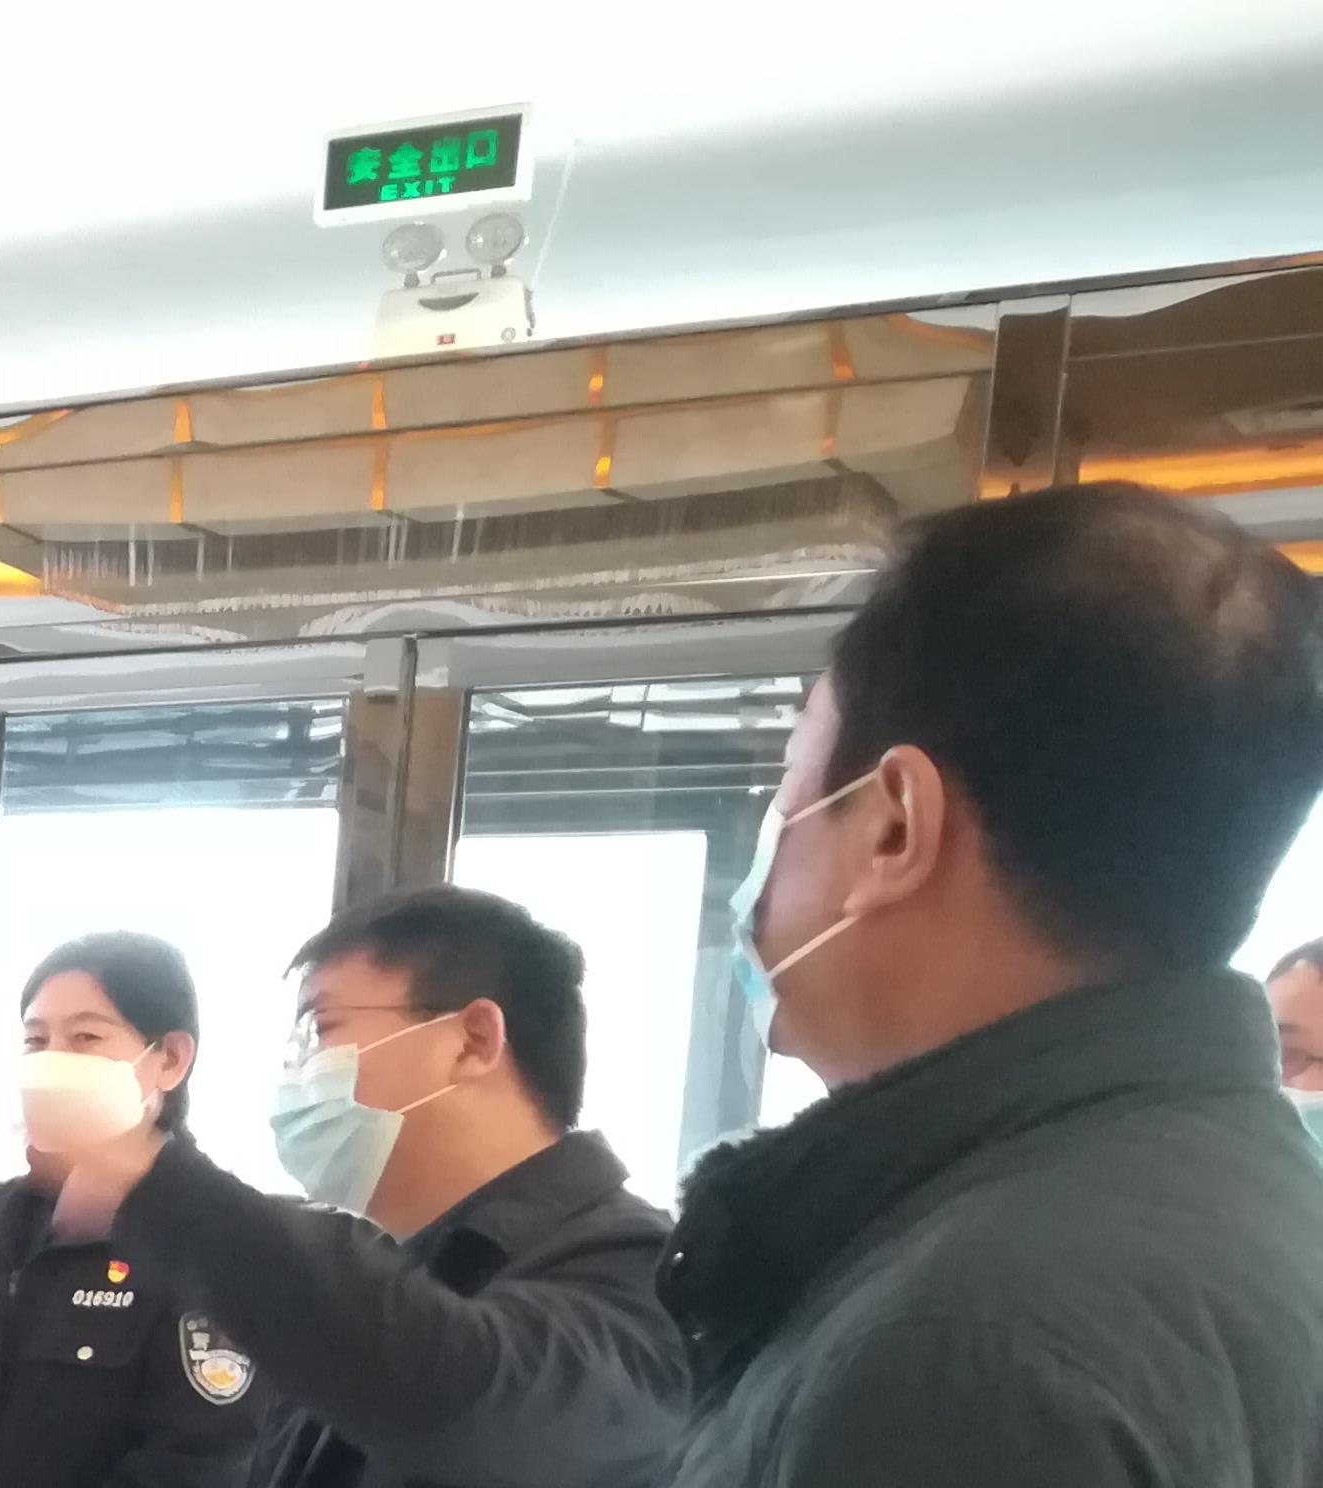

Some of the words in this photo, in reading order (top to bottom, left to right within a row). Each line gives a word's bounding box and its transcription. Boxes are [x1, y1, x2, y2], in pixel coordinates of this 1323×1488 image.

[347, 129, 499, 184] 安全出口
[379, 176, 456, 202] EXIT
